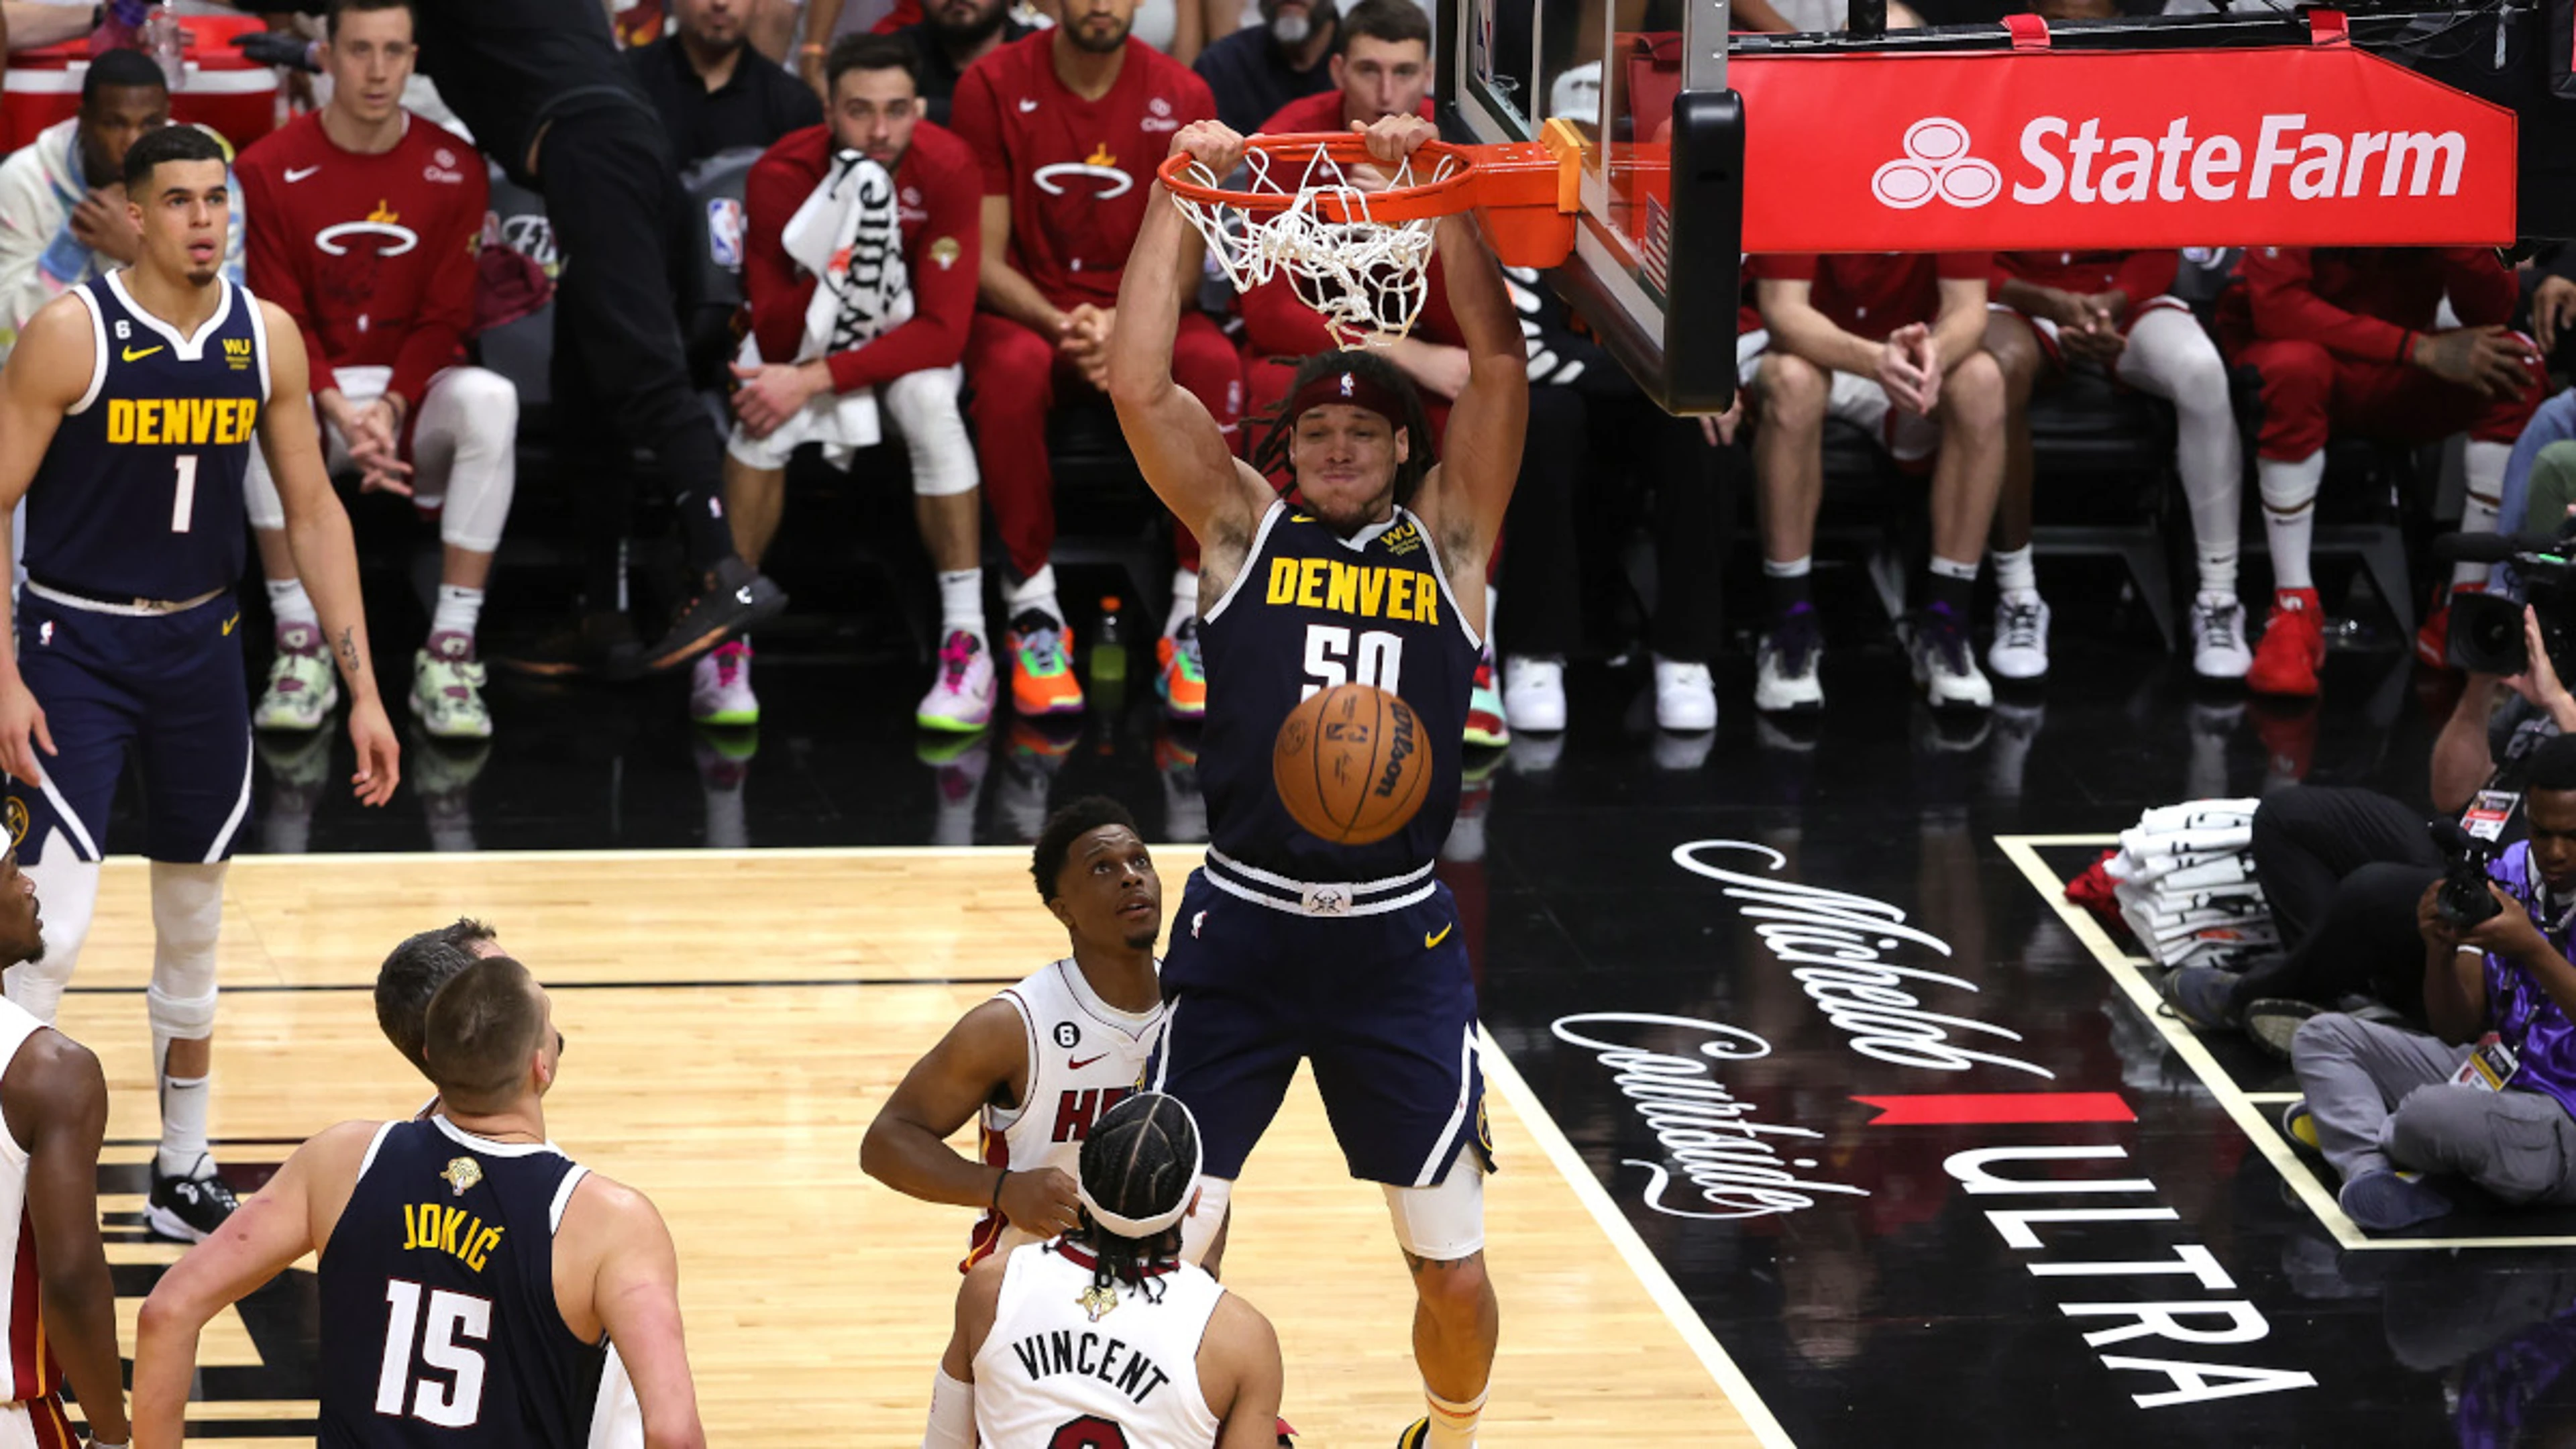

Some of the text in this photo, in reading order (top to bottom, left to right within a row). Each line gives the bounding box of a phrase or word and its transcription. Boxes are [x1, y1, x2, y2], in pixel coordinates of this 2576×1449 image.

[115, 319, 131, 339] 6
[222, 338, 251, 355] WU
[107, 398, 258, 445] DENVER
[171, 454, 198, 533] 1
[1380, 521, 1415, 546] WU
[1266, 557, 1440, 625] DENVER
[1300, 624, 1403, 705] 50
[1375, 702, 1415, 798] Wilson
[1059, 1025, 1075, 1046] 6
[1551, 1012, 1871, 1219] Courtside
[1672, 839, 2319, 1409] Michelob ULTRA
[402, 1202, 505, 1272] JOKIĆ
[374, 1279, 492, 1428] 15
[1012, 1330, 1171, 1405] VINCENT
